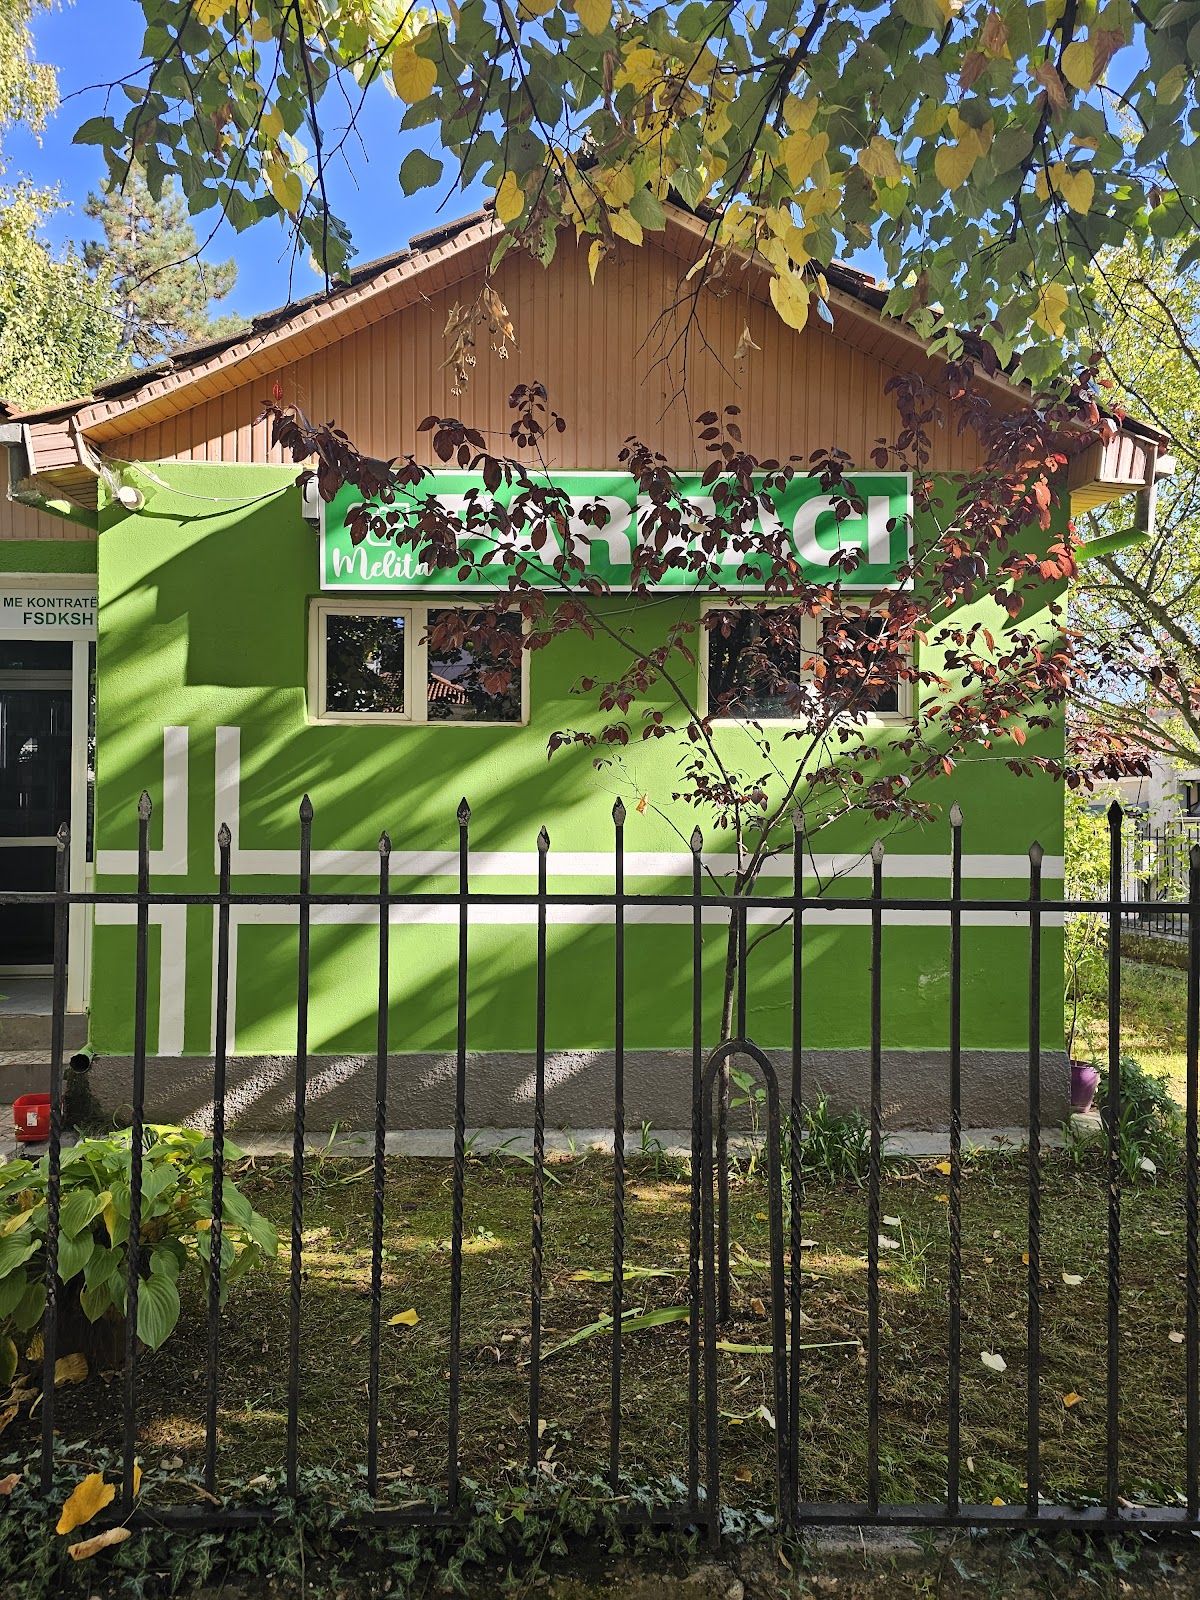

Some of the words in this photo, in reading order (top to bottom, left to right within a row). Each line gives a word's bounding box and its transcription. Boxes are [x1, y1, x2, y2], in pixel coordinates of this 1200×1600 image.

[333, 547, 434, 580] Melita
[3, 597, 23, 608] ME
[23, 612, 93, 625] FSDKSH
